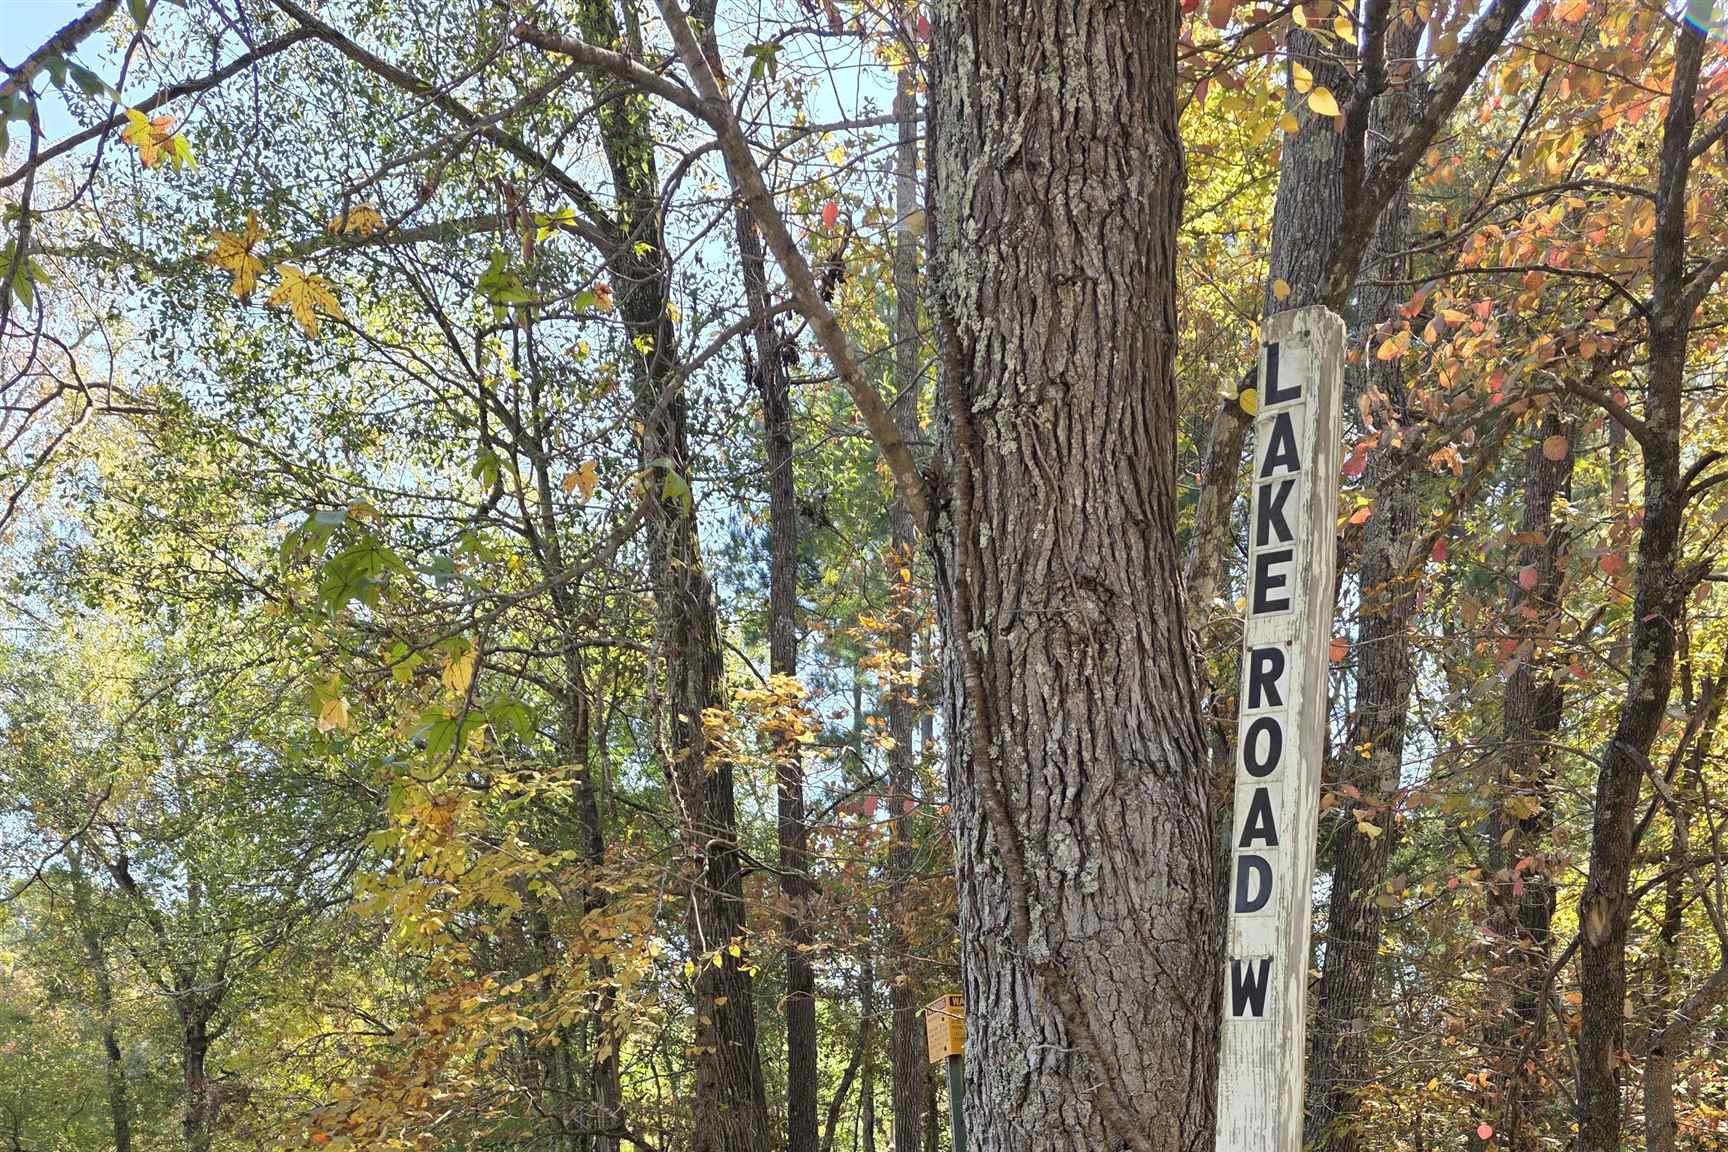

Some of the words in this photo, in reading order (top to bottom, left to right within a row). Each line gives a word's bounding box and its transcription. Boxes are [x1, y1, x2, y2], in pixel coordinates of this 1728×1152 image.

[1253, 341, 1301, 615] LAKE
[1234, 647, 1285, 914] ROAD
[1230, 959, 1270, 1017] W
